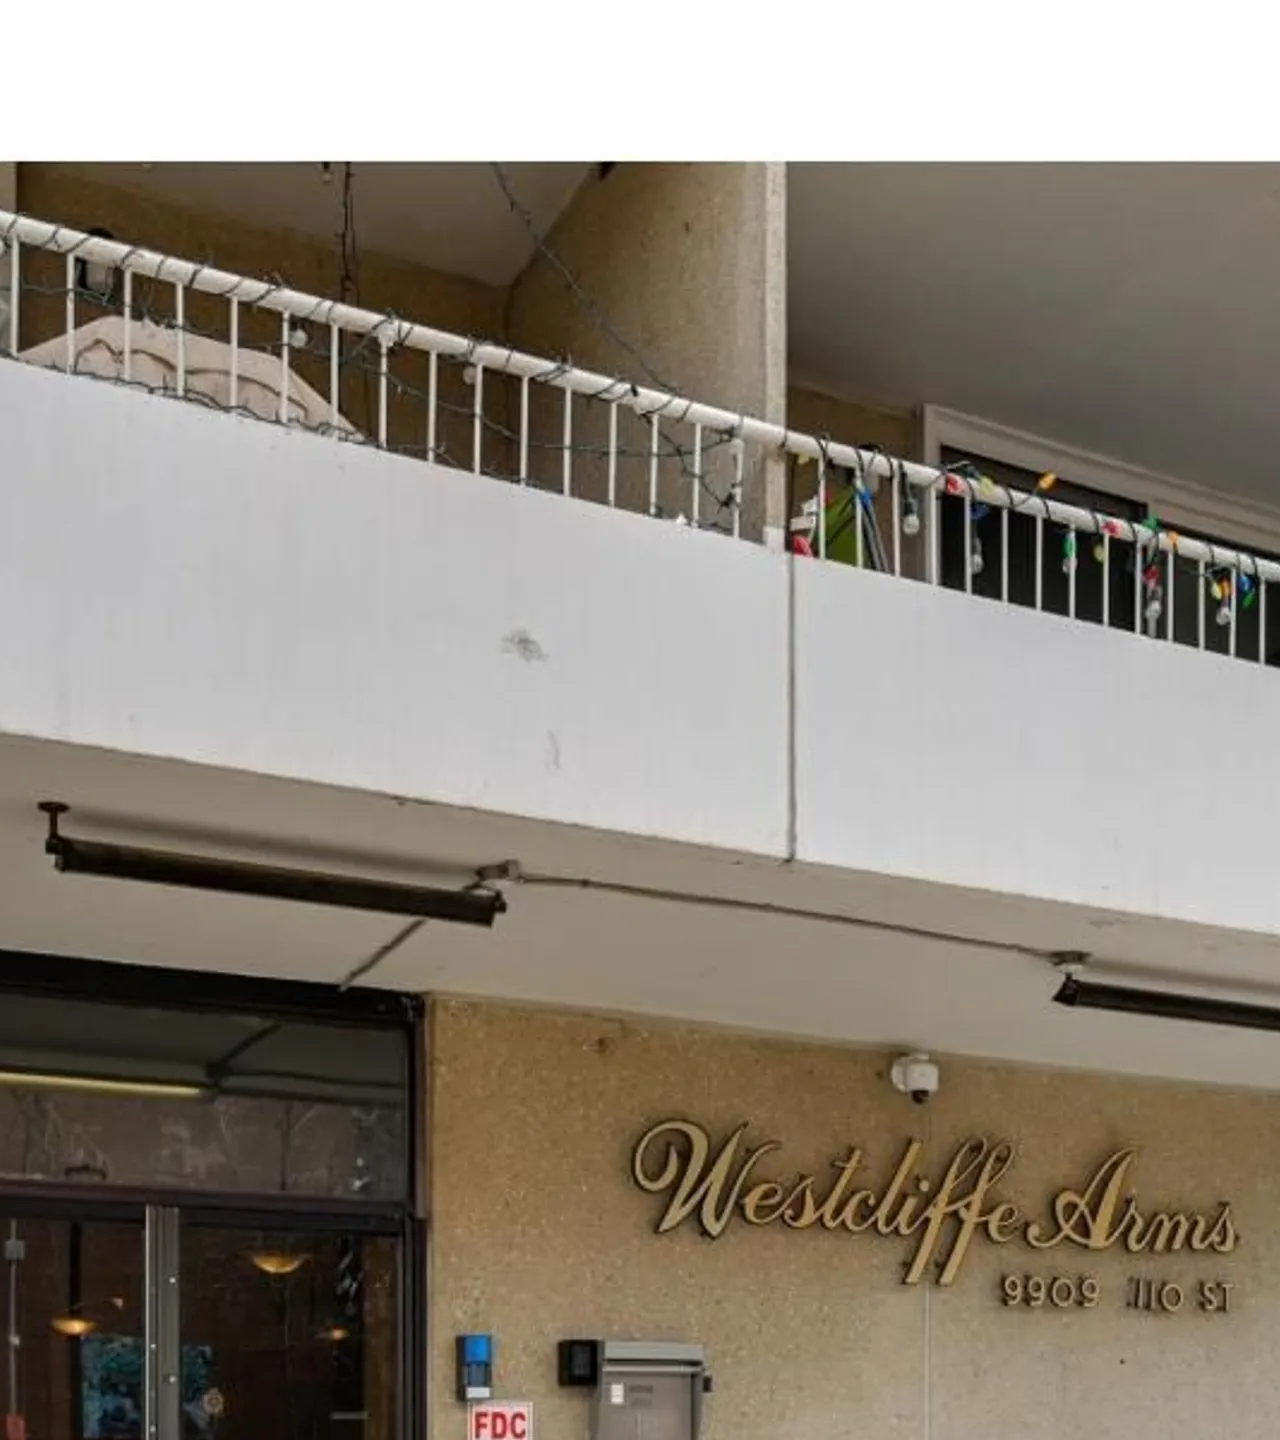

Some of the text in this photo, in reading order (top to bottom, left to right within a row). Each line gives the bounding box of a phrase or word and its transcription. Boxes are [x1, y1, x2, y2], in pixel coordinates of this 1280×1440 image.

[632, 1119, 1238, 1287] Westcliffe Arms
[1001, 1274, 1235, 1312] 9909 110 ST
[474, 1411, 527, 1440] FDC
